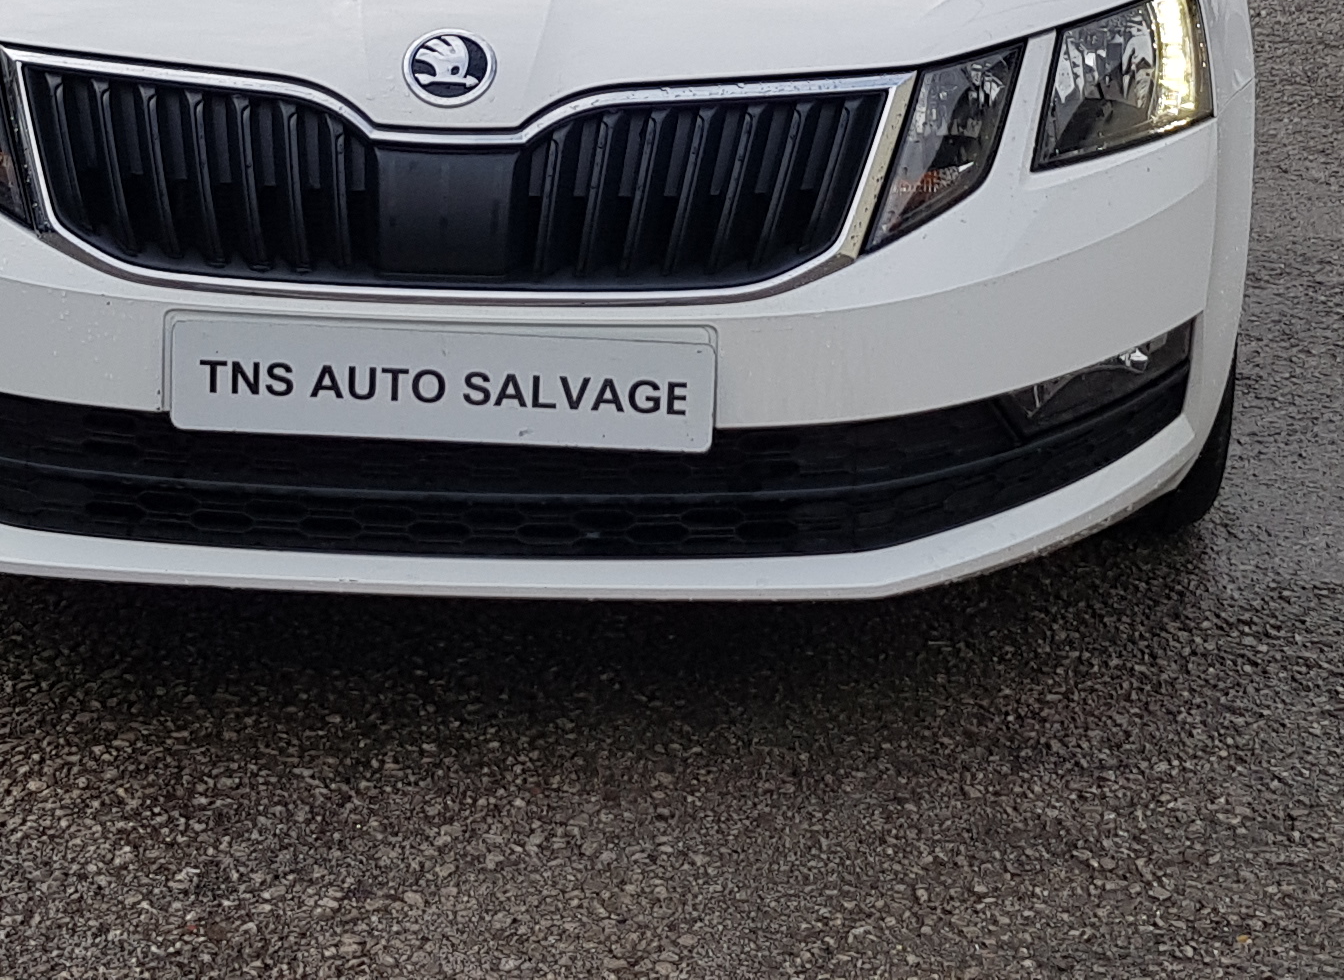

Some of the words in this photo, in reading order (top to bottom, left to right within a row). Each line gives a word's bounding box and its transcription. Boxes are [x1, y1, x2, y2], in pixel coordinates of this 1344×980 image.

[199, 358, 295, 398] TNS
[309, 363, 447, 406] AUTO
[461, 370, 689, 417] SALVAGE
